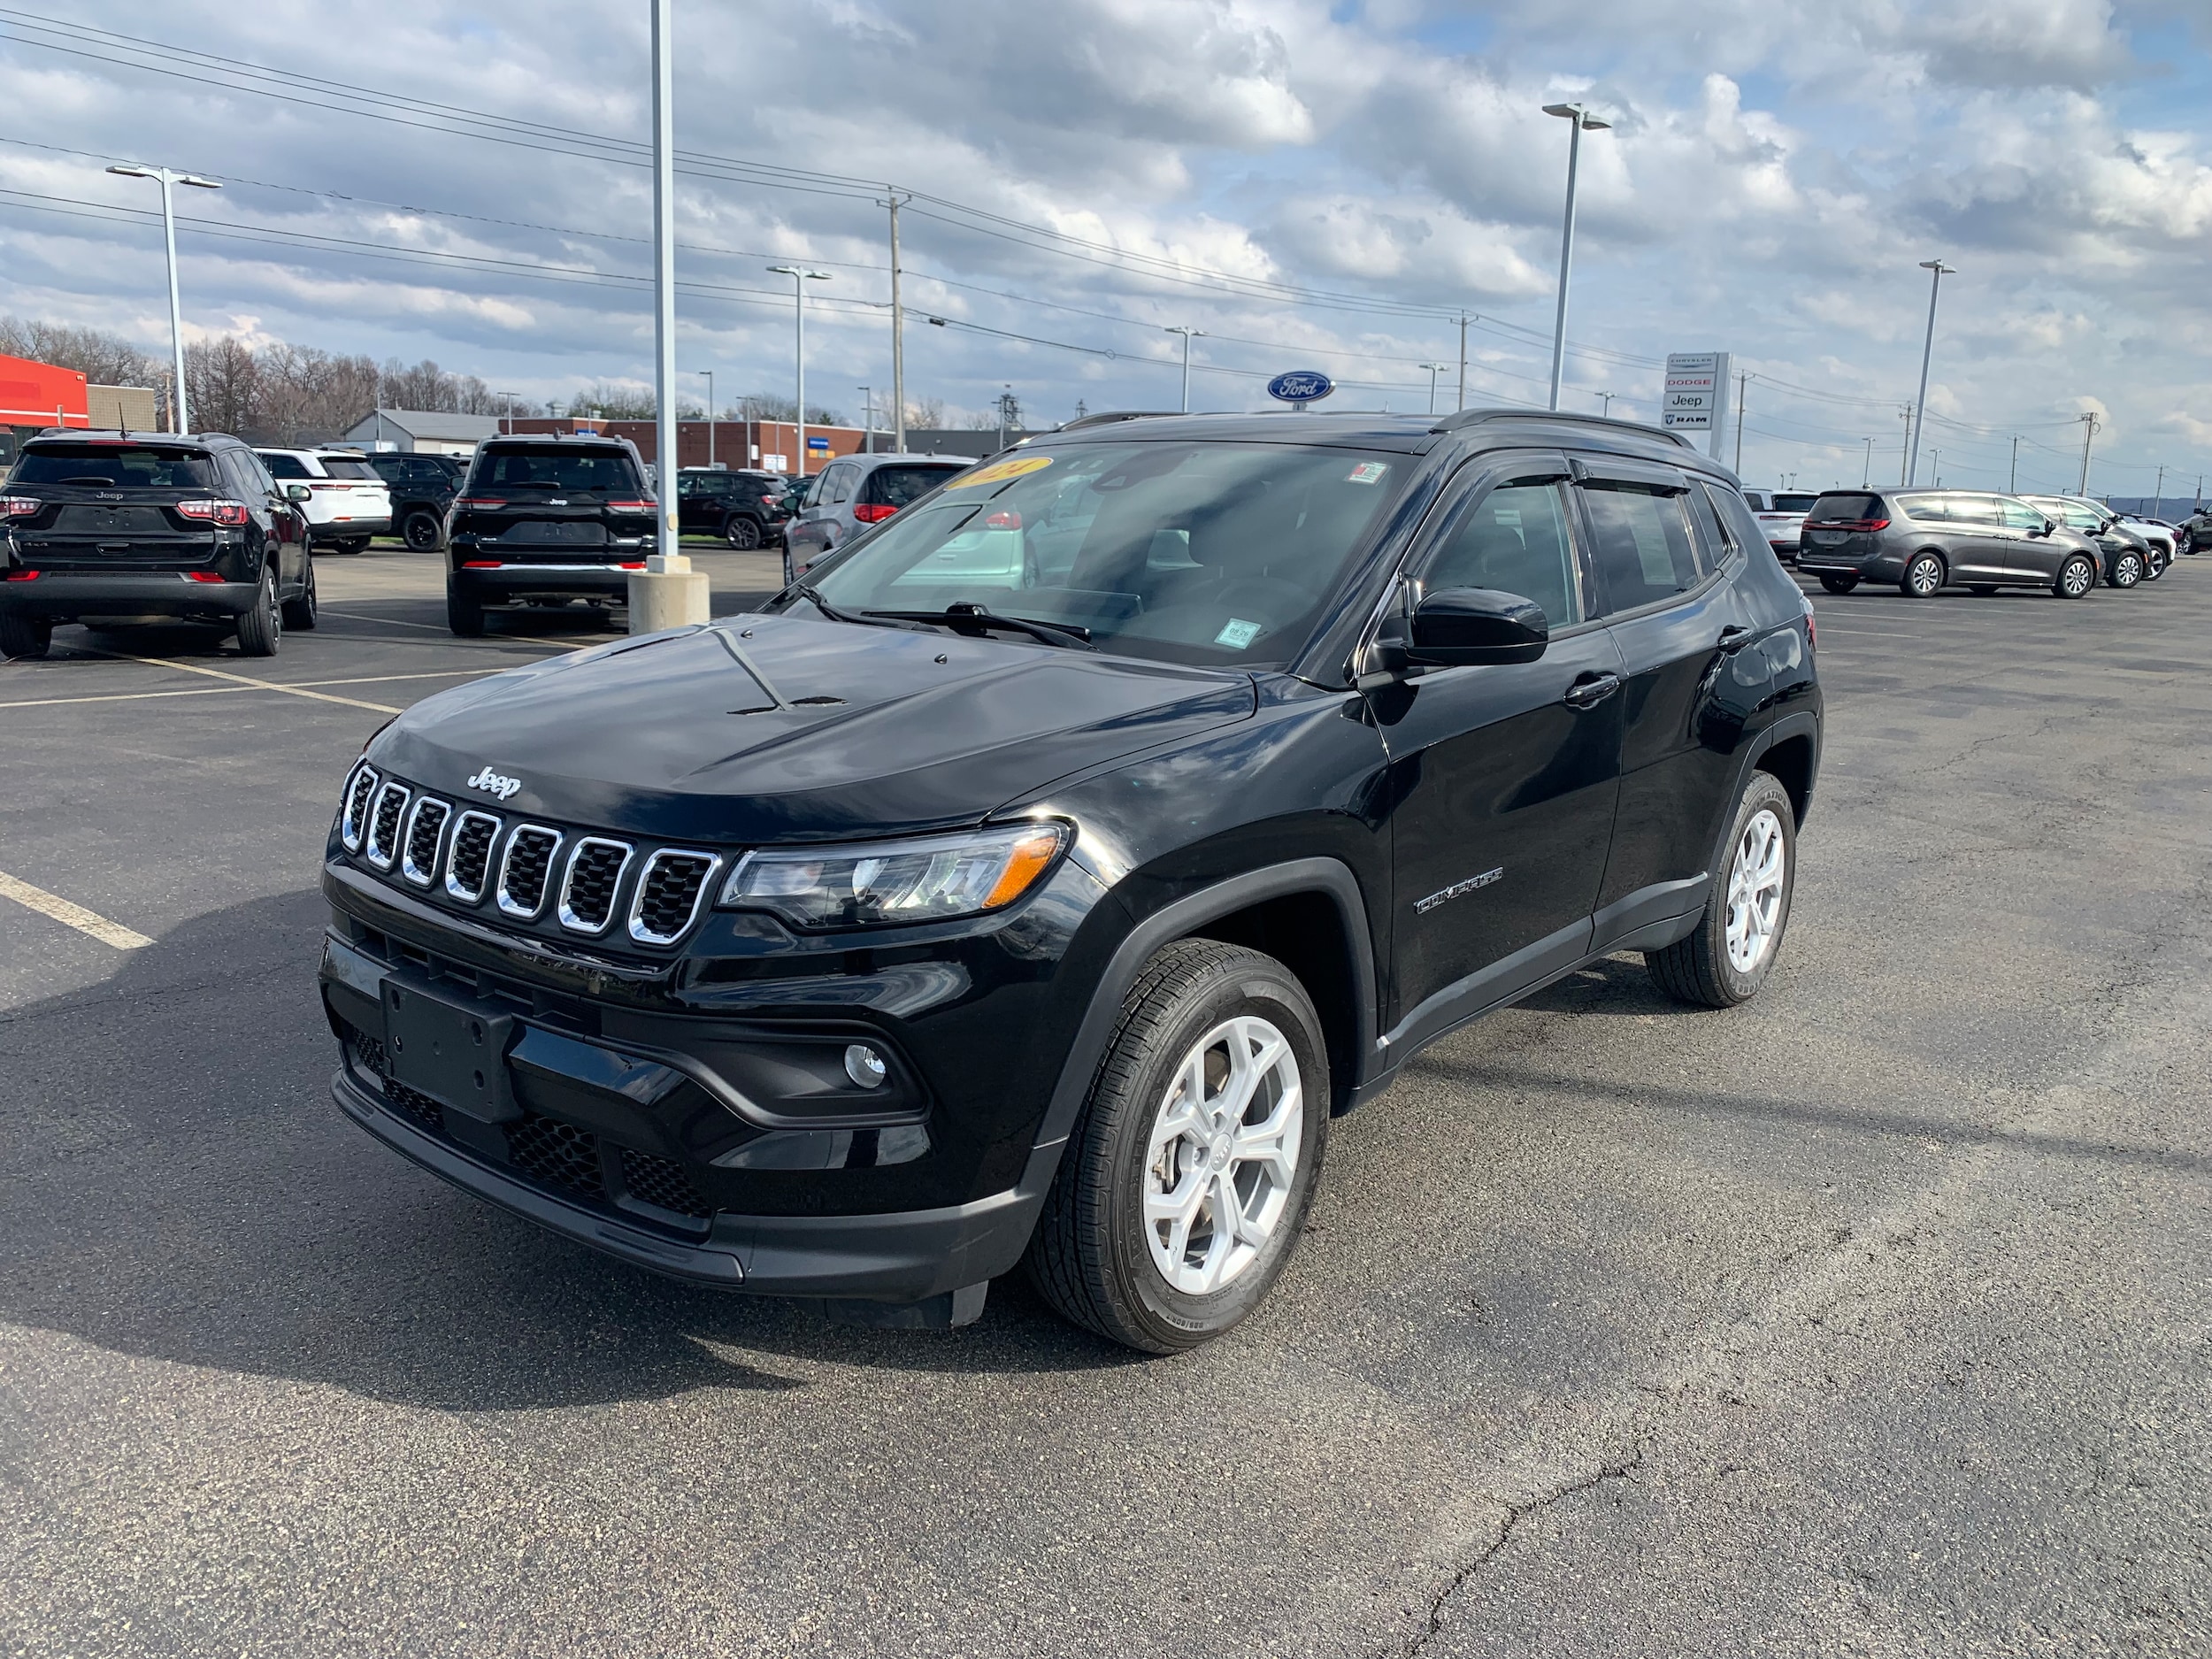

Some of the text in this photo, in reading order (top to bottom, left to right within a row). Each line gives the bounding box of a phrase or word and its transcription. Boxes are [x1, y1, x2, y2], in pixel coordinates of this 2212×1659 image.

[1279, 376, 1318, 396] Ford
[1671, 395, 1702, 407] Jeep
[95, 491, 124, 501] Jeep
[549, 498, 568, 507] Jeep
[467, 765, 521, 801] Jeep
[1413, 866, 1503, 915] COMPASS
